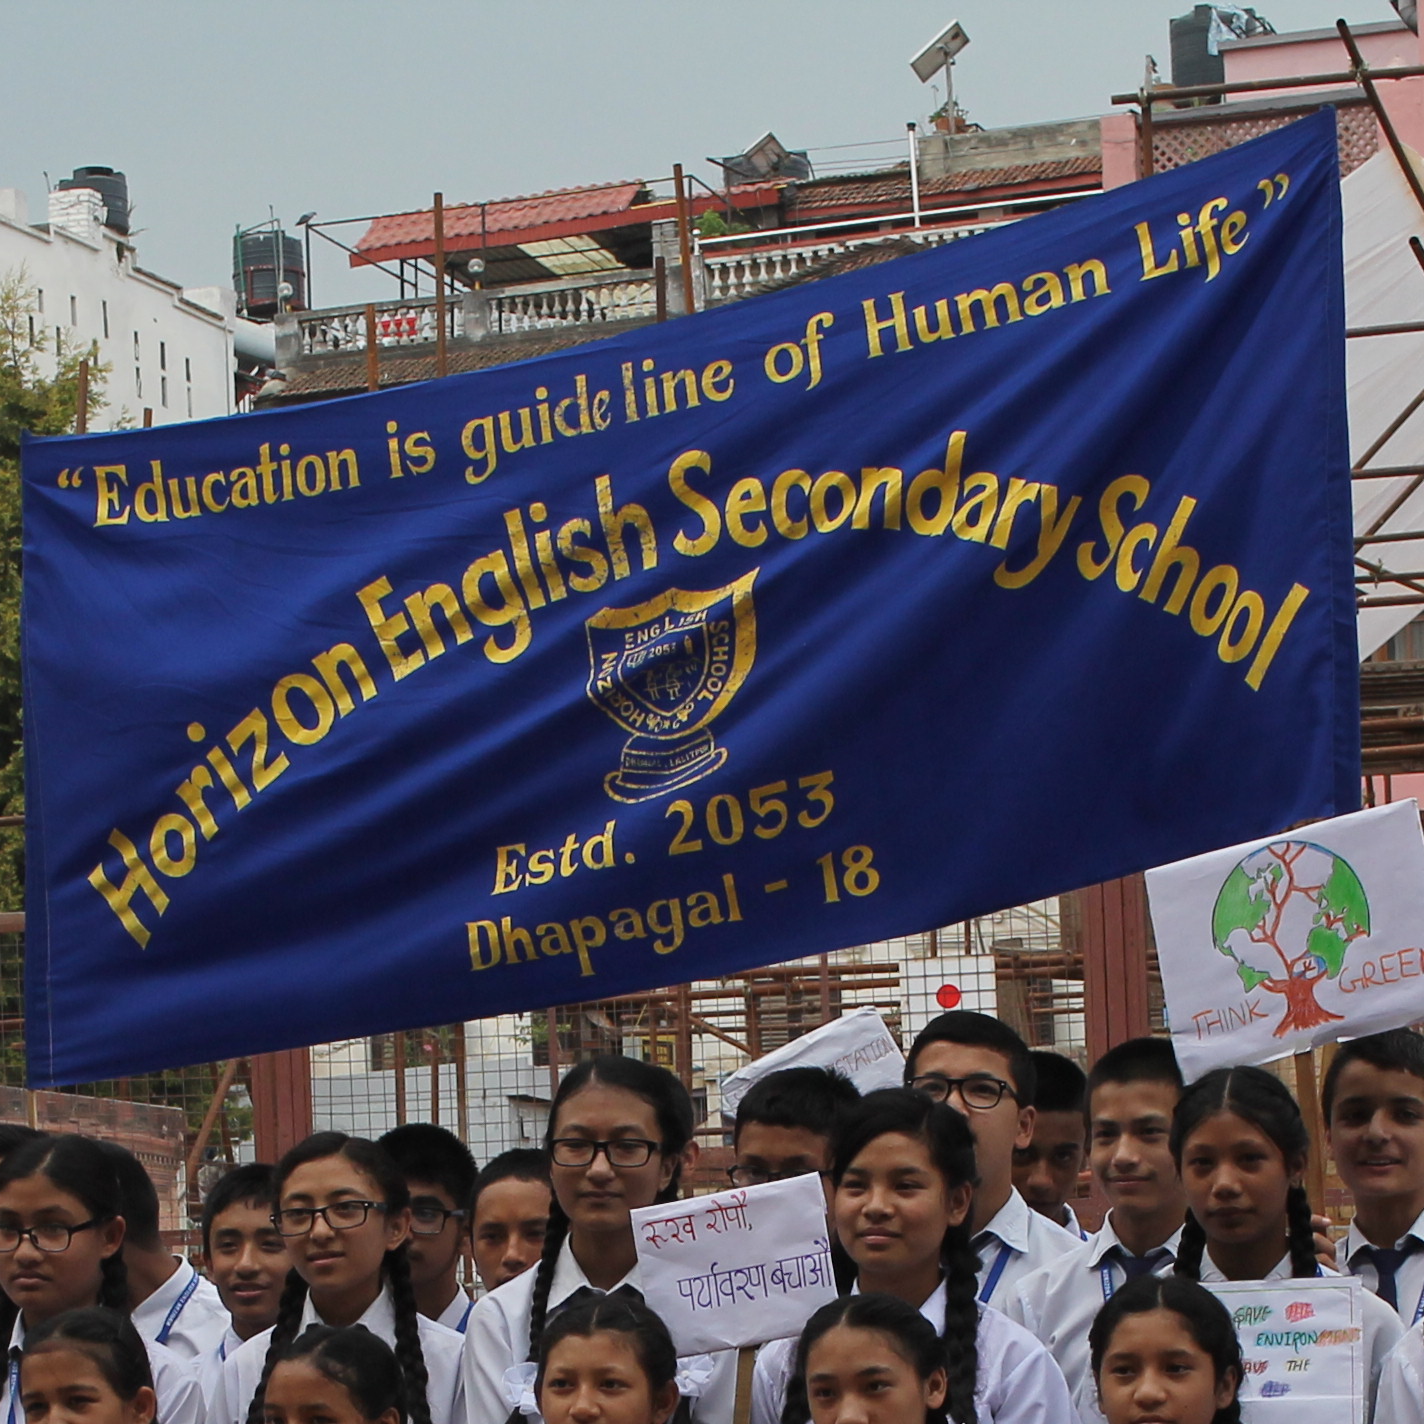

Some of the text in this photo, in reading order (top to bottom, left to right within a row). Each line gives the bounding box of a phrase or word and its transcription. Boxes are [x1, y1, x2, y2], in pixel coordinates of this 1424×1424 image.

[386, 421, 435, 478] is
[764, 312, 834, 391] of
[861, 258, 1111, 359] Human
[625, 610, 708, 649] ENGLISH
[88, 431, 1309, 950] Horizon English Secondary School
[491, 770, 834, 896] Estd. 2053
[465, 873, 743, 976] Dhapagal
[816, 845, 880, 903] 18
[1192, 999, 1269, 1040] THINK
[677, 1262, 768, 1311] पर्यावरण
[1234, 1306, 1272, 1329] SAVE
[1256, 1328, 1361, 1354] ENVIRONMENT
[1244, 1359, 1310, 1375] AVE THE
